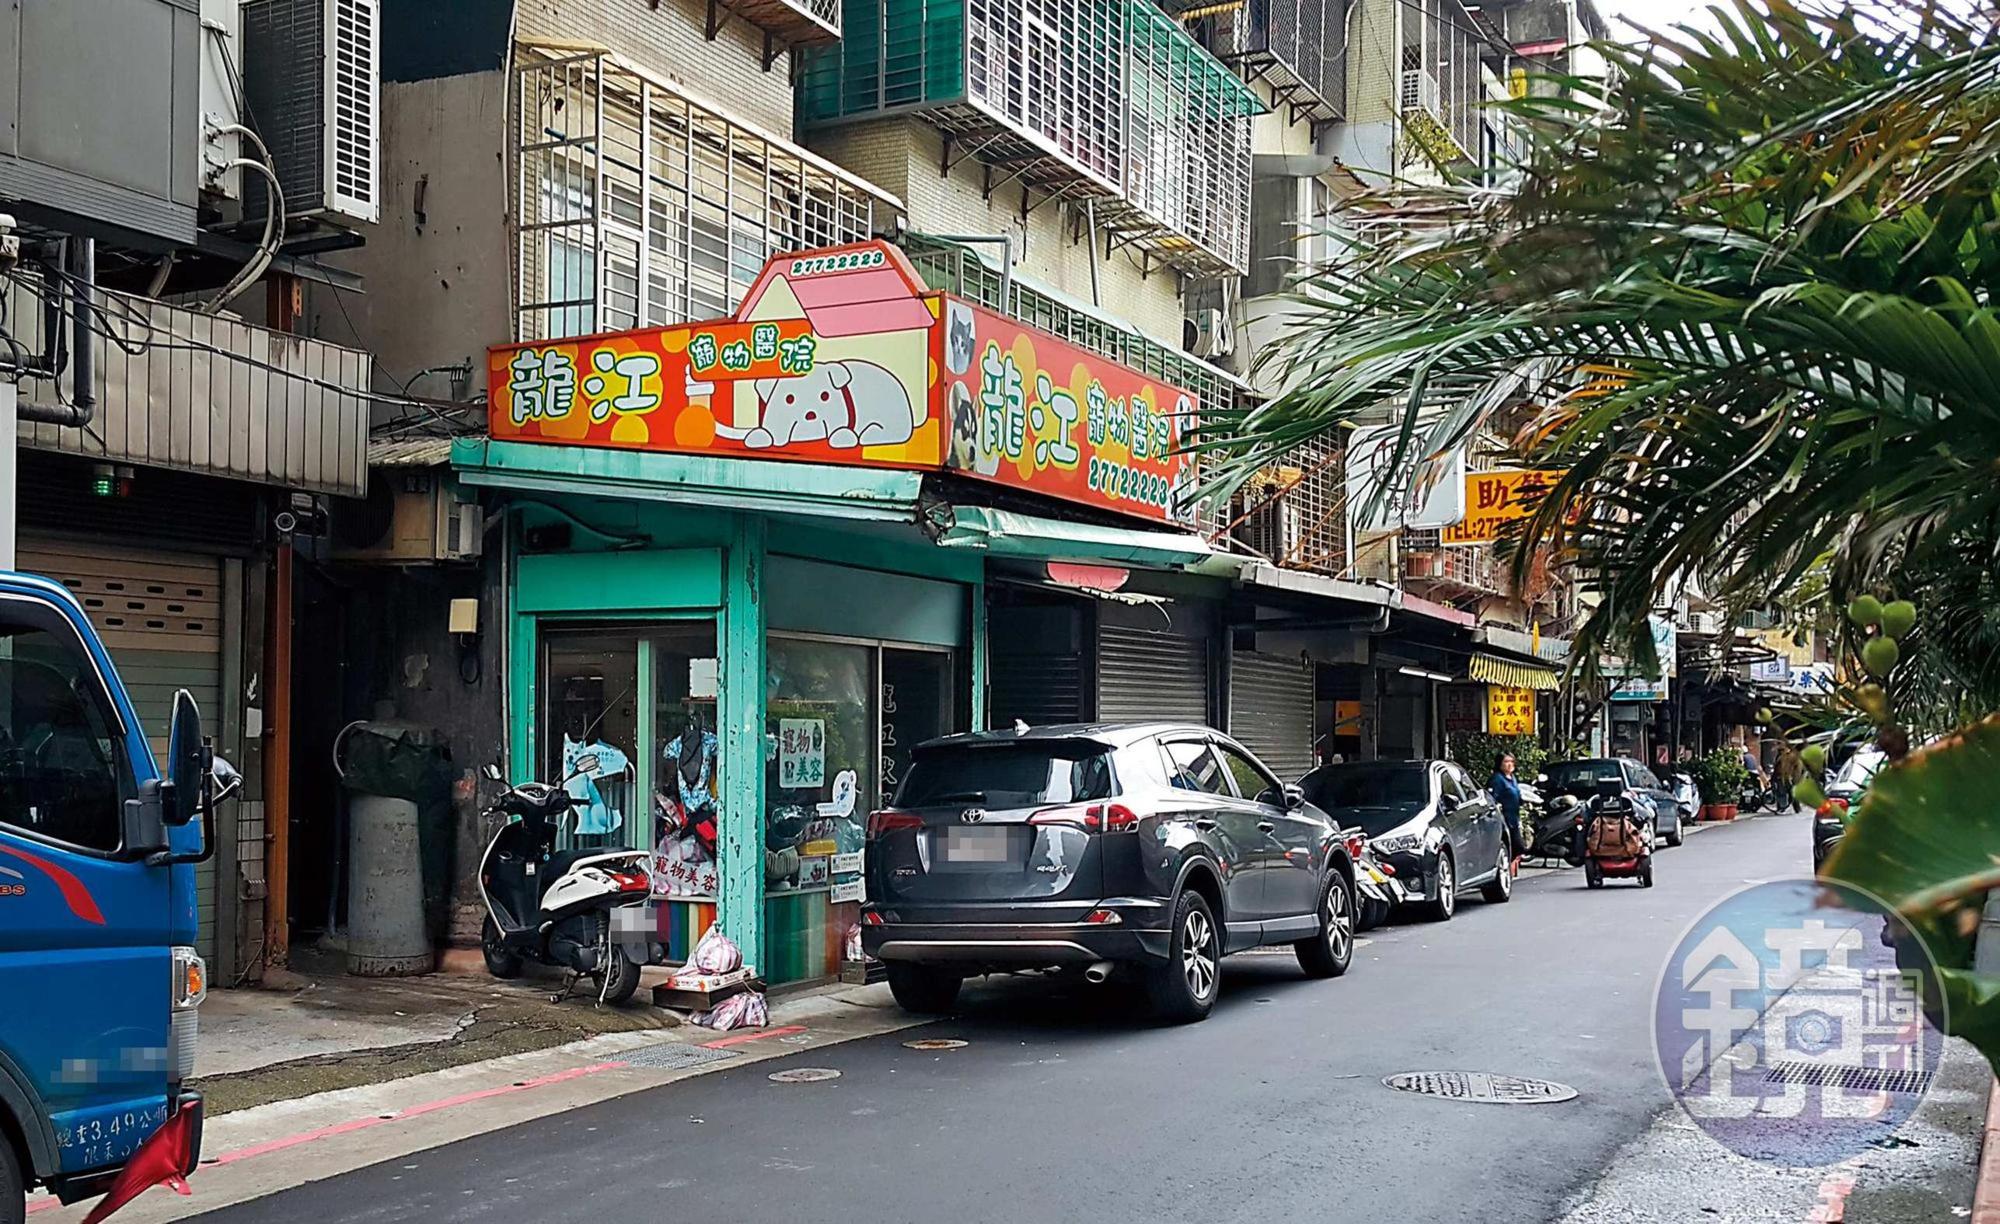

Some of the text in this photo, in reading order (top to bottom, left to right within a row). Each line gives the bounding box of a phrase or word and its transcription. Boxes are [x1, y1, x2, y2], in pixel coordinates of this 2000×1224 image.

[791, 251, 884, 275] 27722223
[510, 323, 816, 424] 龍江 寵物醫院
[983, 342, 1170, 468] 龍江 寵物醫院
[1089, 457, 1169, 505] 27722223
[783, 728, 811, 754] 寵物
[796, 756, 823, 782] 美容
[655, 855, 716, 891] 寵物美容
